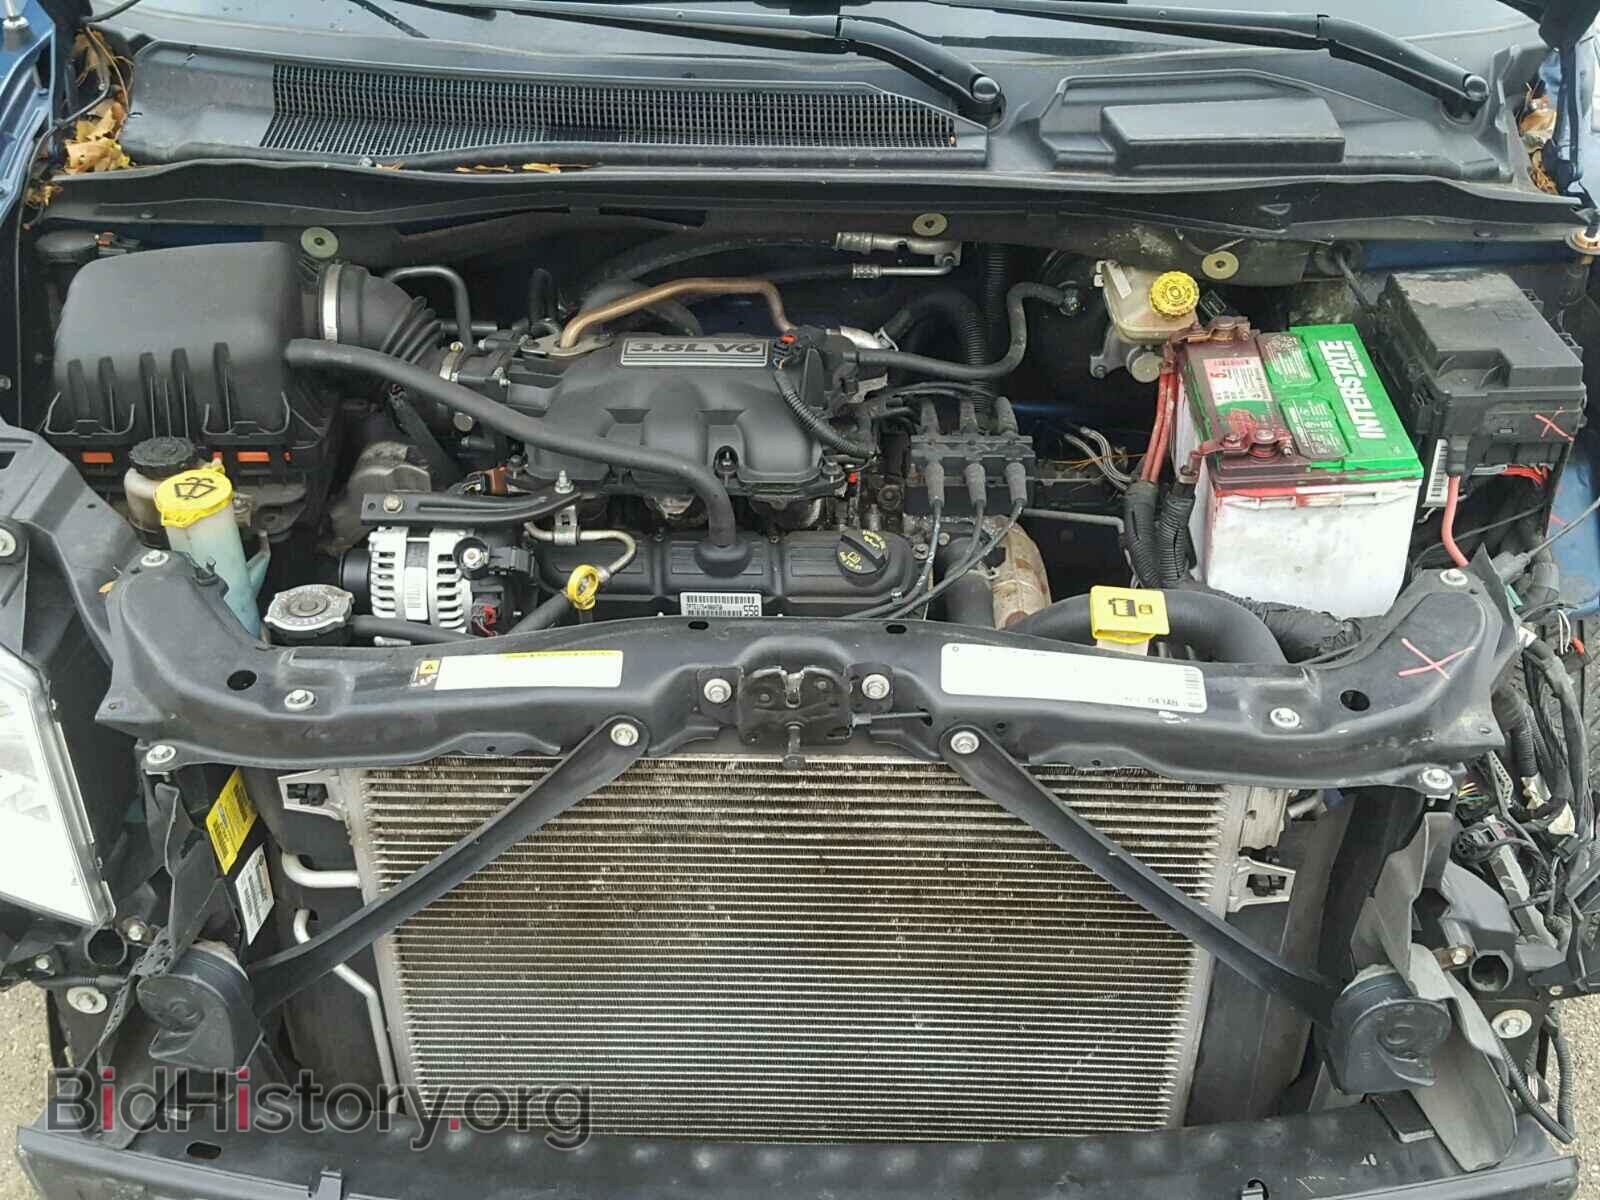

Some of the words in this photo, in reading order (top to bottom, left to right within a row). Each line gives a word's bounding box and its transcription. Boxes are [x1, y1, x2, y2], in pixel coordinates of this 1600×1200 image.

[631, 342, 707, 353] 3.8L
[713, 342, 761, 353] V6
[1318, 340, 1386, 439] INTERSTATE
[743, 605, 760, 617] 558
